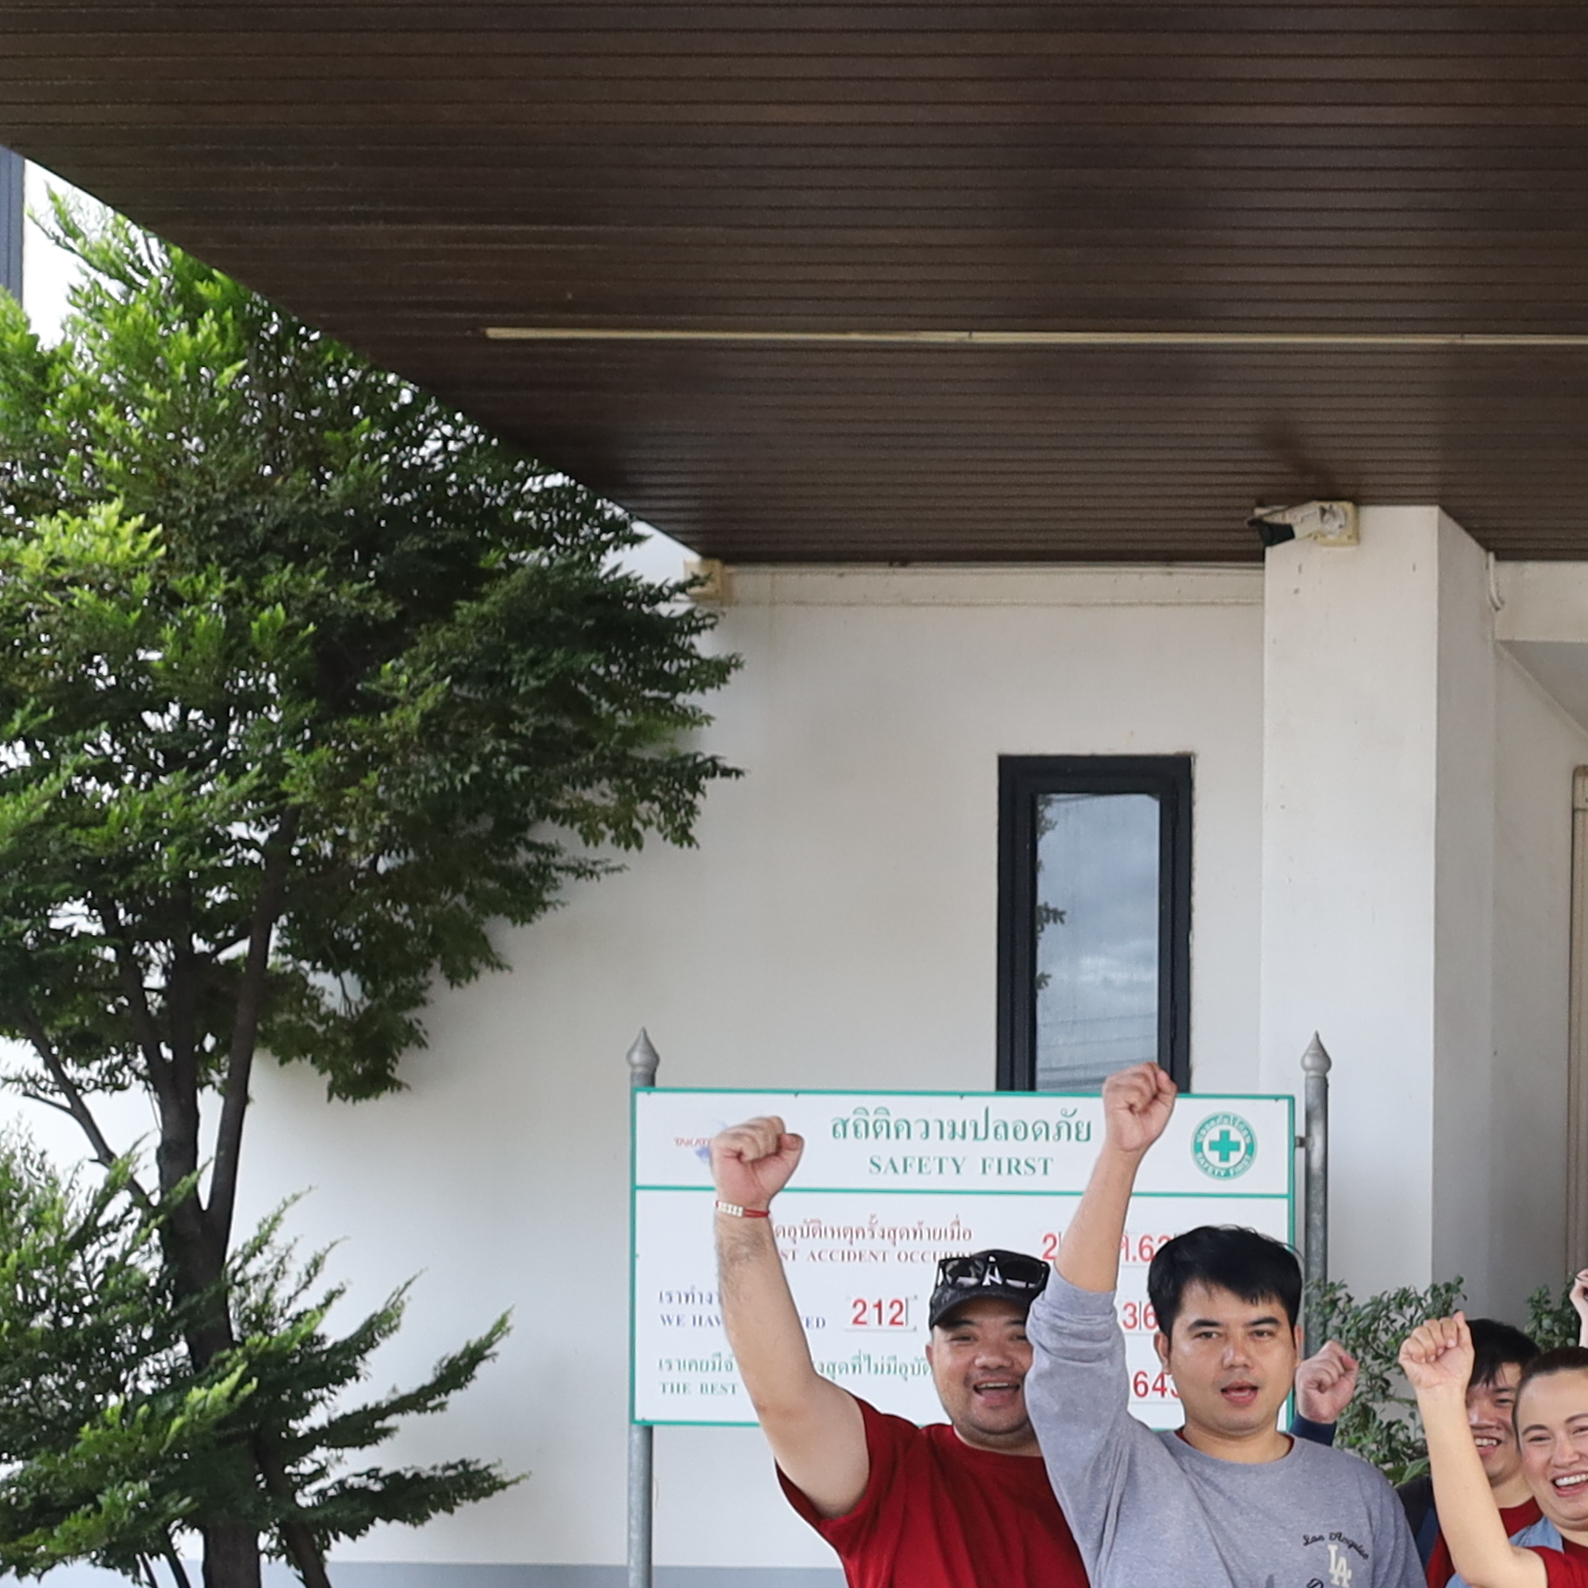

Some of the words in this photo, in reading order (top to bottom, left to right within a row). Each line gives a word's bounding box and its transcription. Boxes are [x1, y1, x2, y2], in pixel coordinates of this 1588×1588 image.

[830, 1105, 1093, 1143] สถิติความปลอดภัย
[868, 1155, 966, 1176] SAFETY
[980, 1156, 1054, 1177] FIRST
[806, 1249, 889, 1263] ACCIDENT
[660, 1313, 685, 1328] WE
[852, 1298, 905, 1327] 212
[659, 1382, 691, 1396] THE
[699, 1382, 738, 1396] BEST
